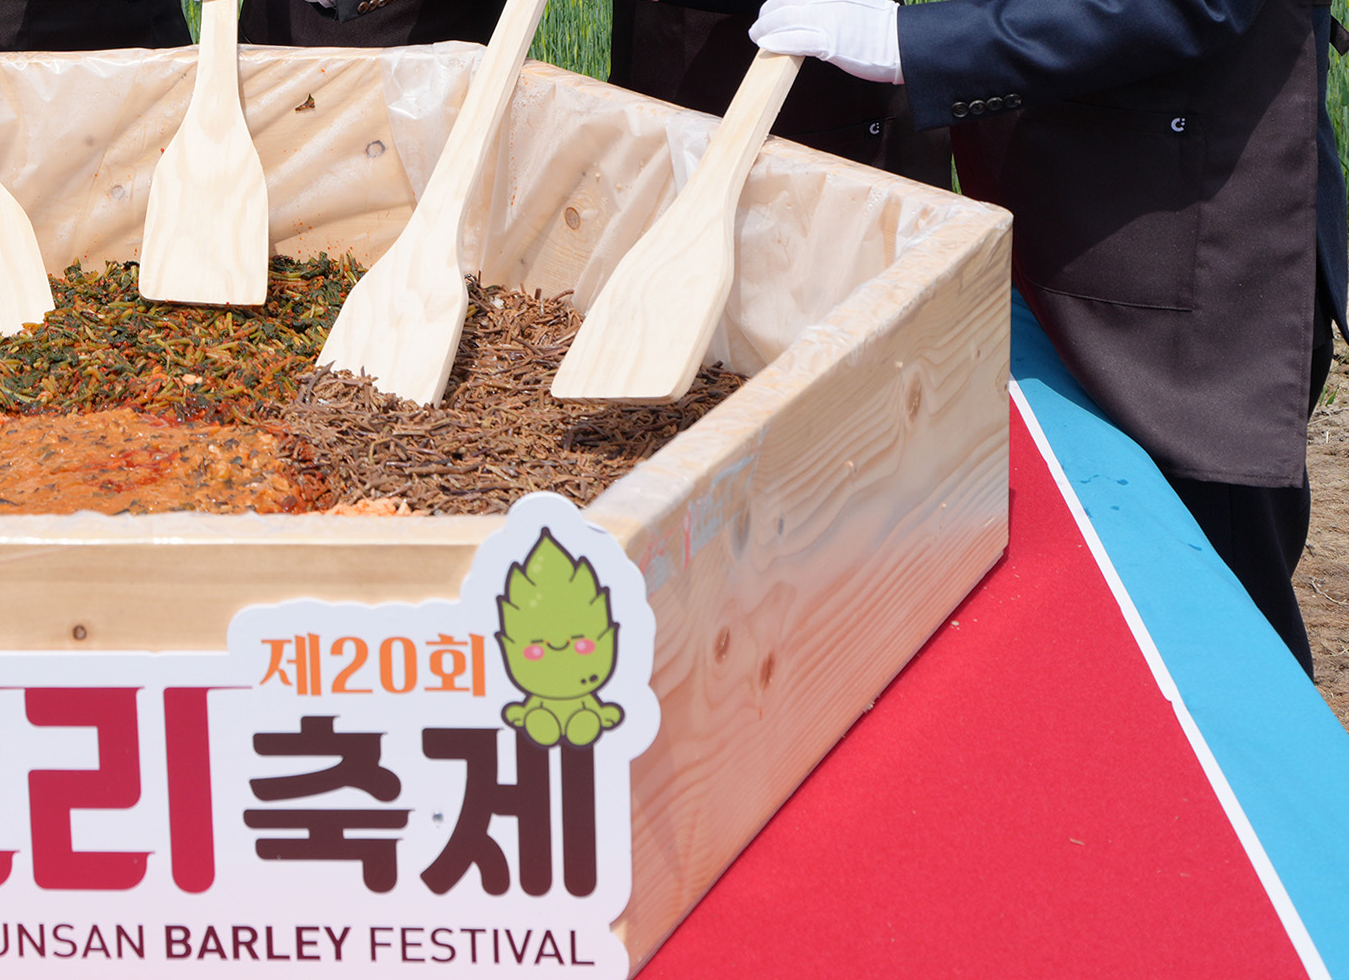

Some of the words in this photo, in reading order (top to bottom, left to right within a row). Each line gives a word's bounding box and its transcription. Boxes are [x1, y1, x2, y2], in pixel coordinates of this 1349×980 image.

[258, 631, 487, 698] 제20회
[242, 714, 598, 899] 축제
[164, 924, 352, 962] BARLEY
[368, 926, 596, 967] FESTIVAL
